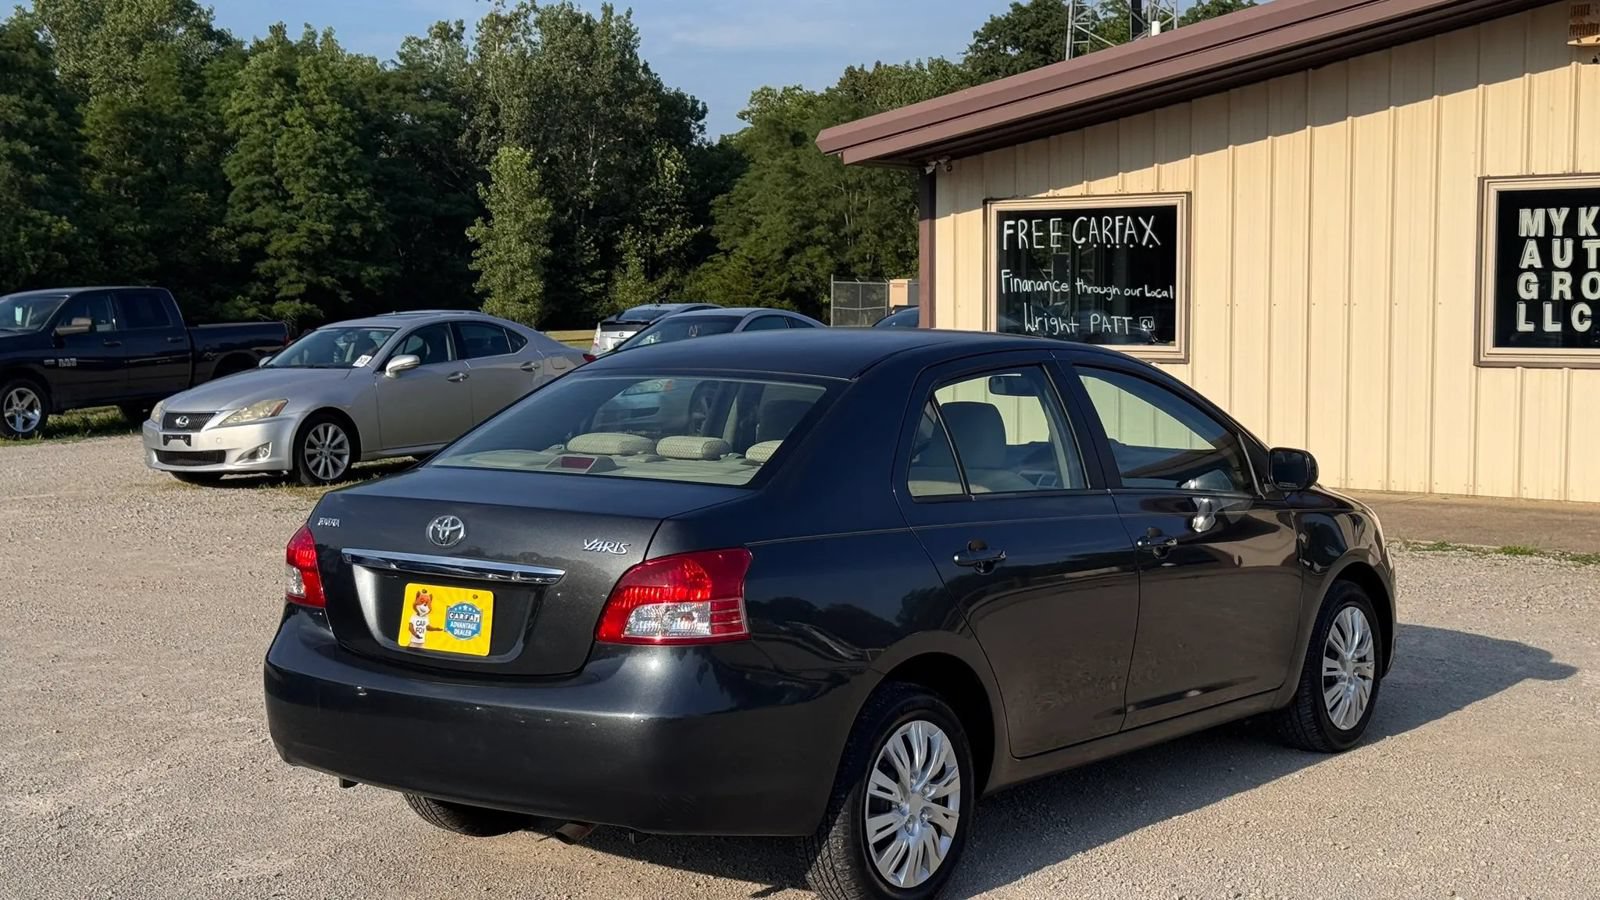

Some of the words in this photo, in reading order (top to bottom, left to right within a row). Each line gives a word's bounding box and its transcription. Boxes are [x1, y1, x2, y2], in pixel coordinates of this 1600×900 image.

[1002, 217, 1062, 250] FREE
[1072, 215, 1161, 248] CARFAX
[1518, 238, 1600, 269] AUT
[1001, 269, 1070, 294] Finanance
[1075, 277, 1121, 301] through
[1123, 286, 1142, 297] our
[1516, 271, 1600, 300] GRO
[1023, 302, 1080, 335] Wright
[1090, 313, 1133, 335] PATT
[1516, 301, 1593, 332] LLC
[583, 538, 631, 554] YARIS
